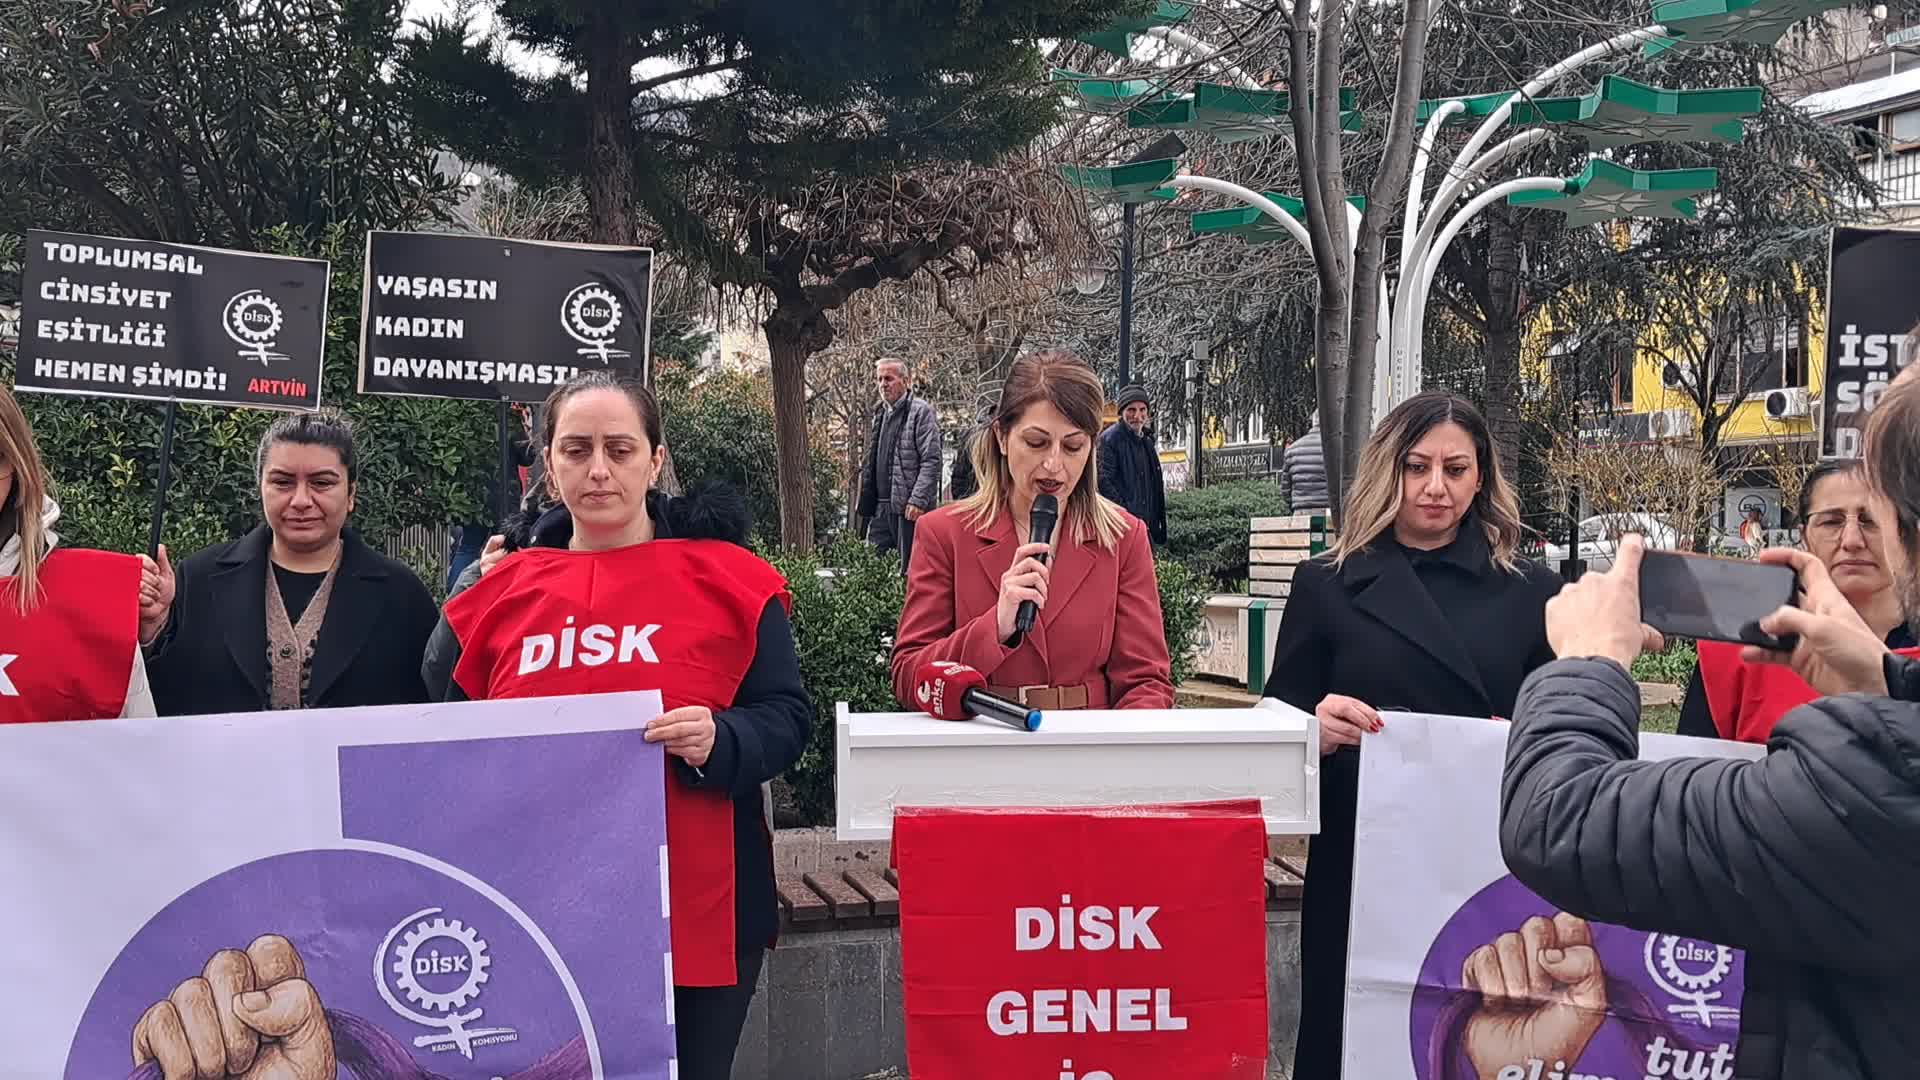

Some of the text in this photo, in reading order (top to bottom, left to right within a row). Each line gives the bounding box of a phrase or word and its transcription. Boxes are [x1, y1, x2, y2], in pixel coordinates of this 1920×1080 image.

[43, 242, 203, 275] TOPLUMSAL
[40, 277, 172, 309] CİNSİYET
[377, 275, 497, 300] YAŞASIN
[243, 309, 272, 324] DİSK
[583, 304, 611, 319] DİSK
[37, 317, 167, 348] EŞİTLİĞİ
[375, 316, 465, 339] KADIN
[35, 358, 228, 391] HEMEN ŞİMDİ!
[248, 378, 307, 397] ARTVİN
[517, 615, 663, 676] DİSK
[1015, 894, 1162, 951] DİSK
[415, 949, 470, 975] DİSK
[1676, 942, 1717, 963] DİSK
[986, 987, 1188, 1036] GENEL
[1646, 1036, 1735, 1080] tut
